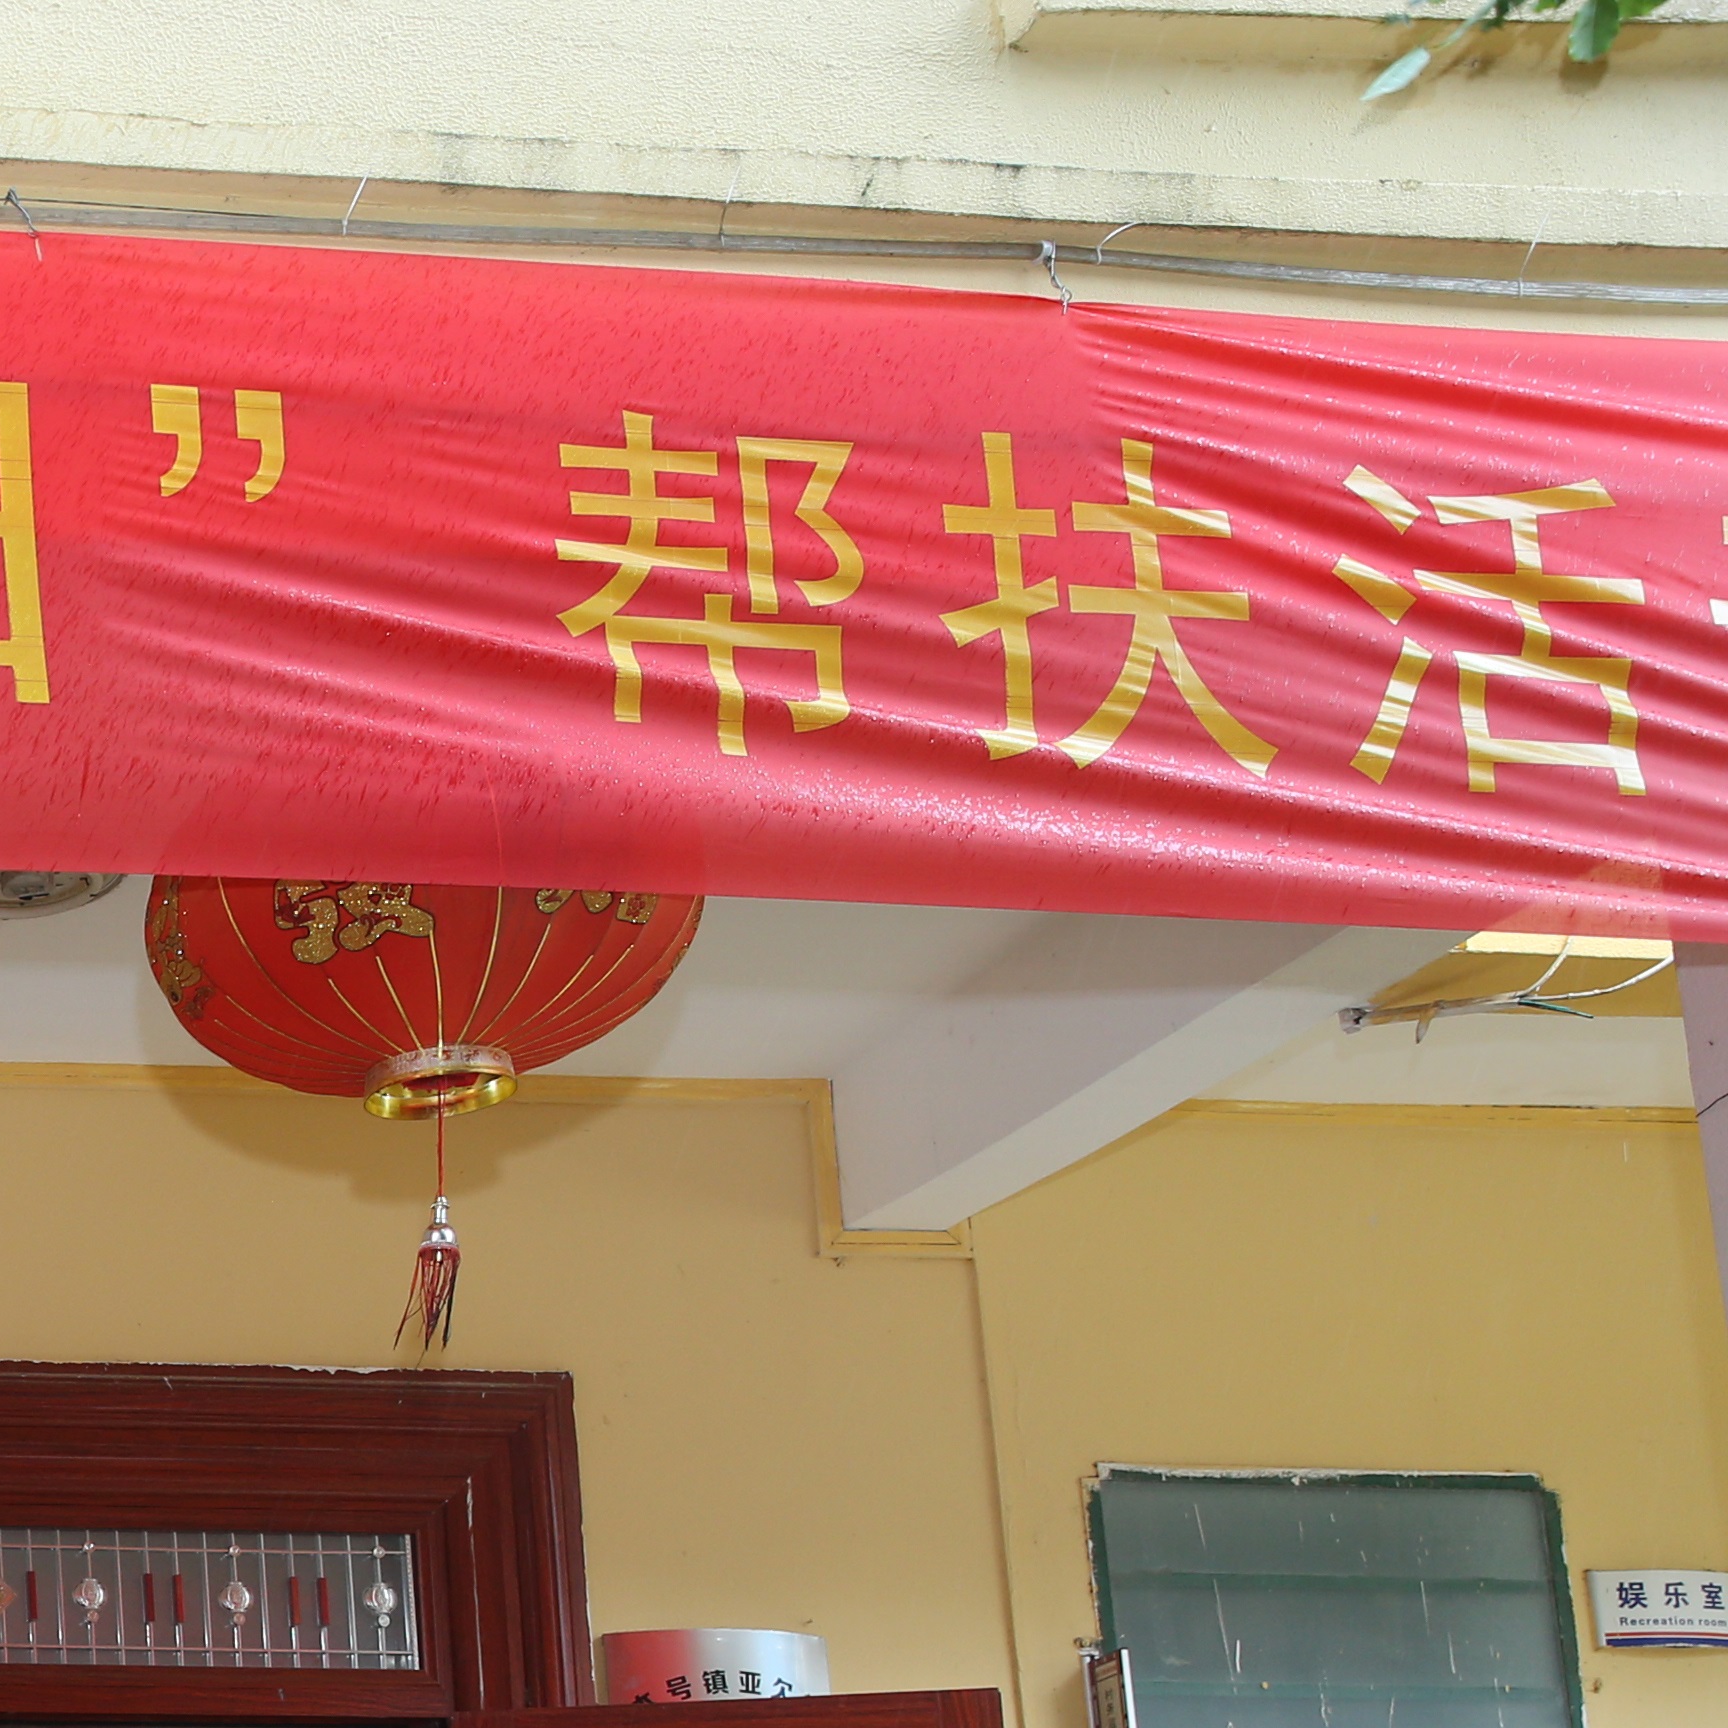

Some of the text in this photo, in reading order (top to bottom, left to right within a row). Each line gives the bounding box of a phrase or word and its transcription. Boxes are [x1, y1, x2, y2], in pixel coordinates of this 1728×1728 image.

[1616, 1581, 1725, 1610] 娱乐室
[1619, 1616, 1727, 1627] Recreation room
[632, 1669, 811, 1705] 号镇亚欠
